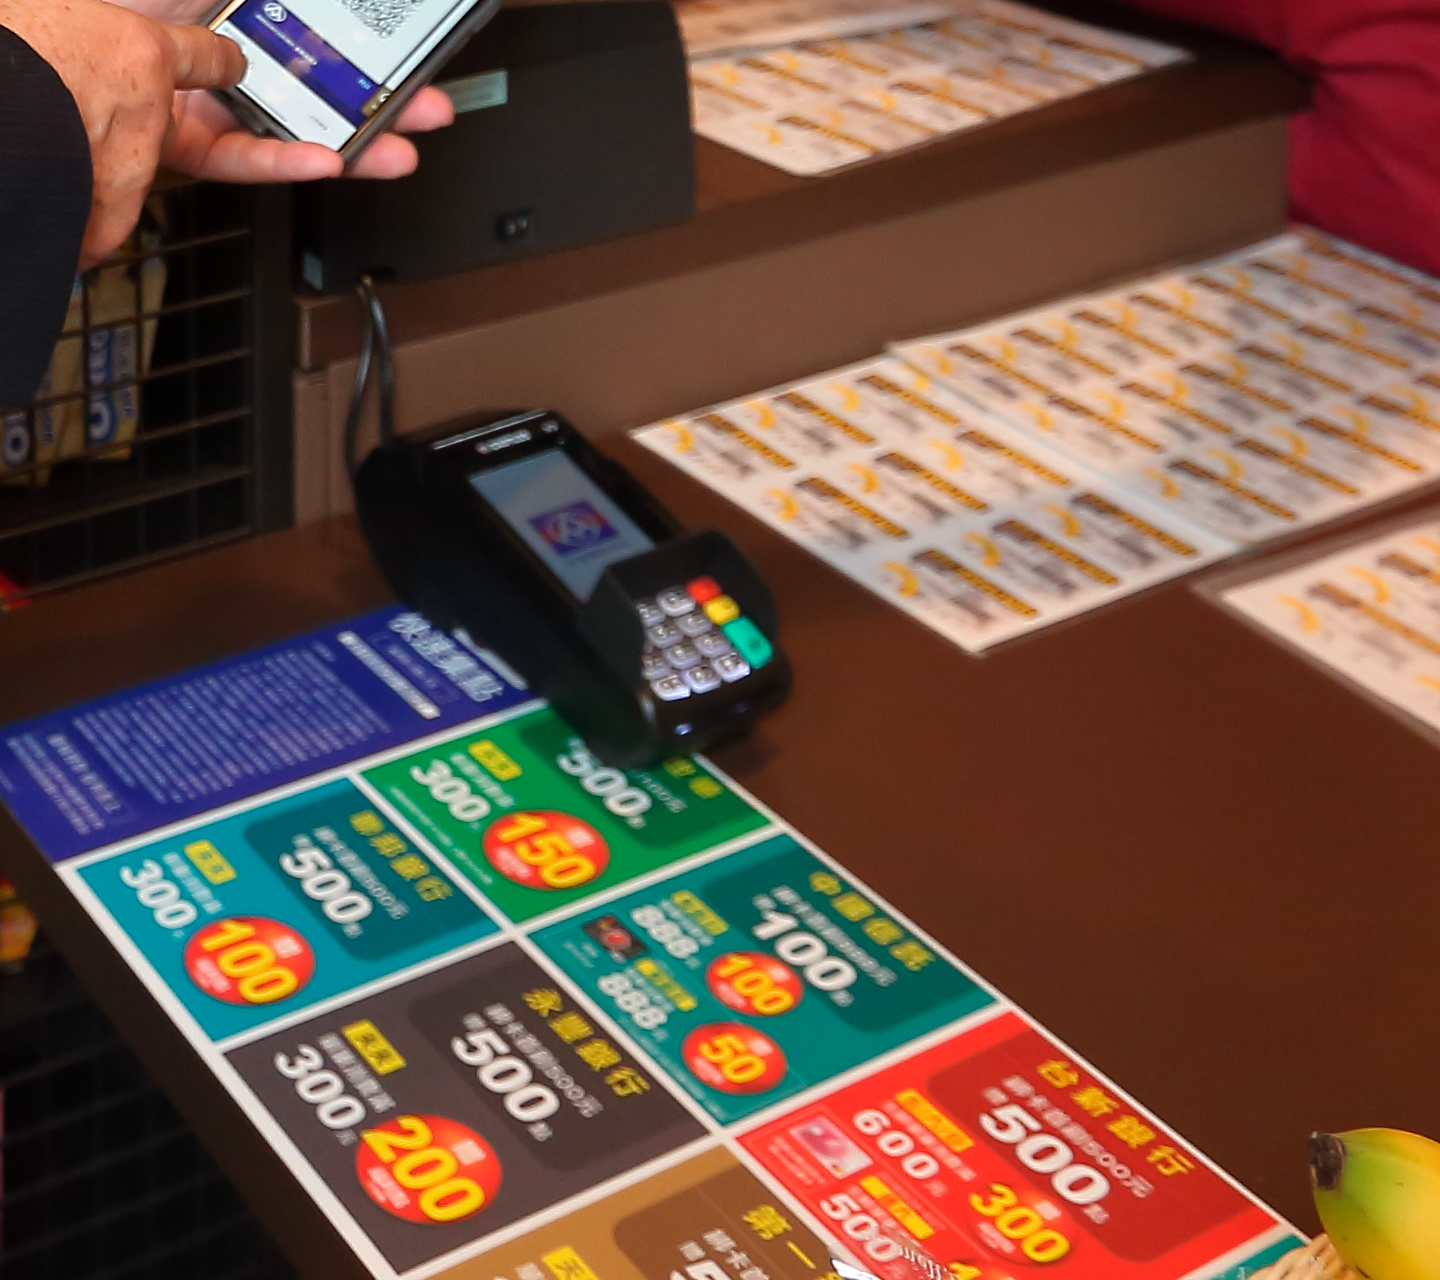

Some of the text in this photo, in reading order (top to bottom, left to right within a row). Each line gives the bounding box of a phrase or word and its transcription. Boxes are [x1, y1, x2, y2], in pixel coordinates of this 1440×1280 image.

[200, 918, 299, 1004] 100
[524, 990, 650, 1096] 永豐銀行
[361, 1117, 484, 1220] 200
[1037, 1060, 1193, 1176] 台新銀行
[969, 1184, 1069, 1262] 300
